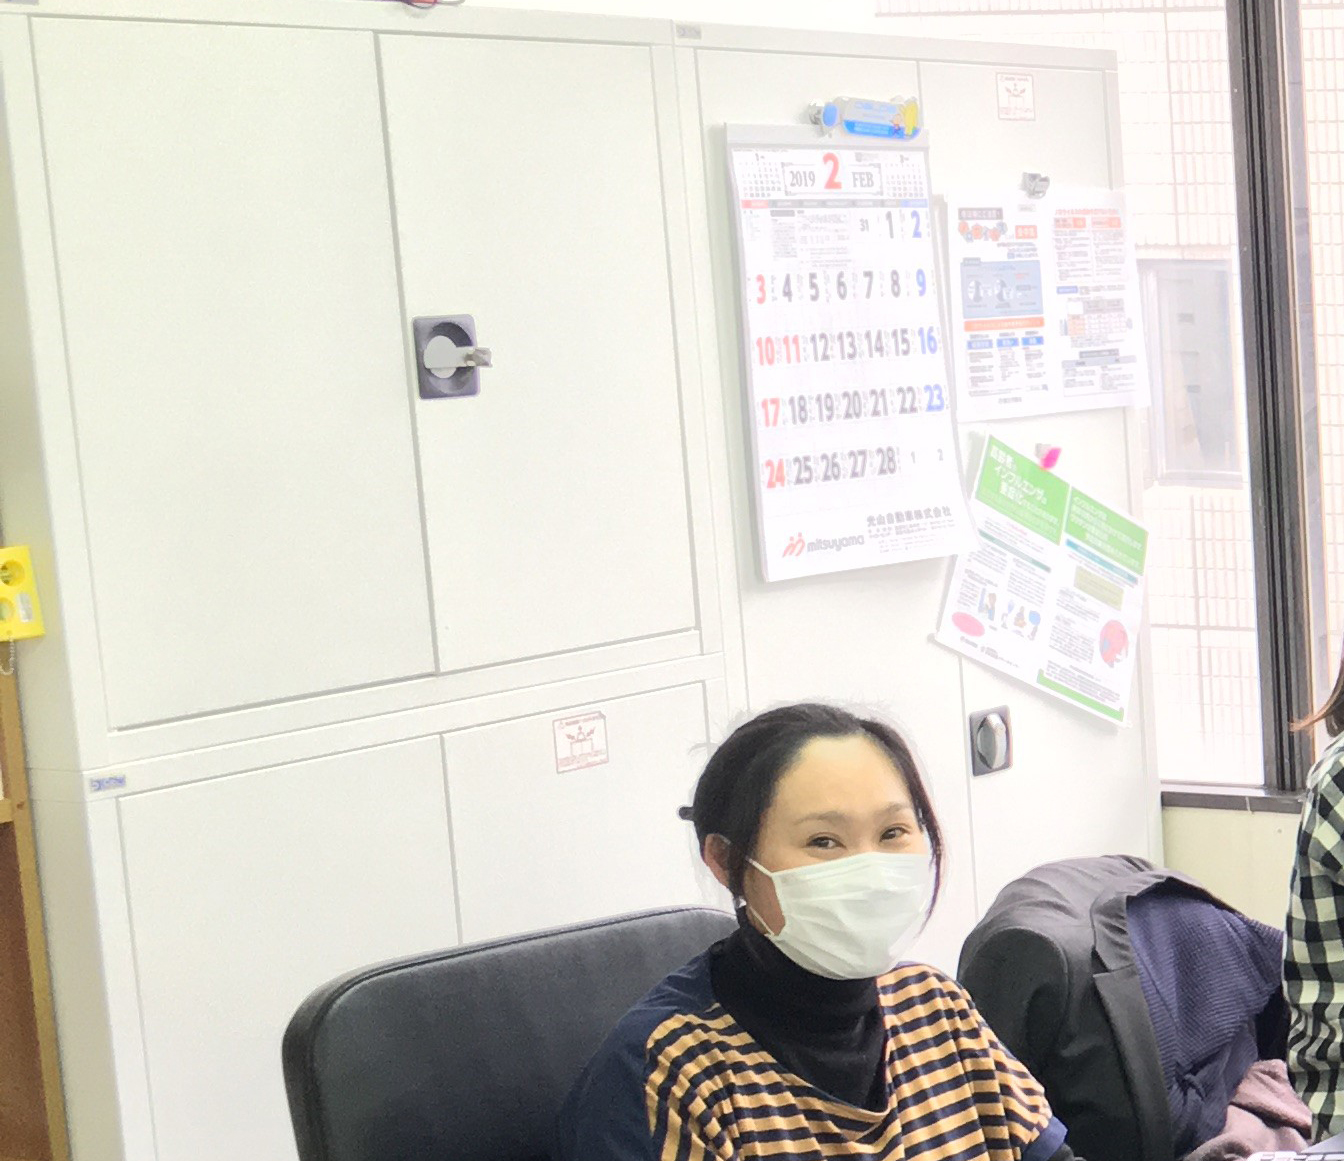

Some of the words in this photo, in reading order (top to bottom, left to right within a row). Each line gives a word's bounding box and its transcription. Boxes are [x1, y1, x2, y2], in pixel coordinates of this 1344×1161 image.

[789, 171, 816, 188] 2019
[822, 152, 843, 190] 2
[852, 171, 875, 188] FEB
[859, 218, 870, 232] 31
[885, 210, 894, 239] 1
[910, 209, 922, 239] 2
[755, 273, 767, 305] 3
[782, 272, 793, 302] 4
[808, 272, 820, 302] 5
[836, 270, 848, 300] 6
[863, 270, 874, 299] 7
[890, 269, 901, 298] 8
[915, 268, 927, 297] 9
[756, 336, 775, 366] 10
[783, 334, 801, 364] 11
[810, 332, 831, 362] 12
[837, 331, 858, 361] 13
[864, 329, 885, 358] 14
[891, 328, 911, 356] 15
[918, 326, 938, 354] 16
[761, 397, 781, 428] 17
[788, 394, 809, 425] 18
[815, 392, 835, 422] 19
[842, 390, 863, 420] 20
[869, 388, 889, 417] 21
[896, 386, 918, 415] 22
[923, 383, 945, 412] 23
[764, 458, 785, 489] 24
[792, 455, 813, 485] 25
[820, 452, 841, 482] 26
[847, 448, 868, 479] 27
[875, 446, 896, 476] 28
[911, 450, 916, 464] 1
[937, 448, 944, 461] 2
[807, 535, 865, 553] mitsuyama
